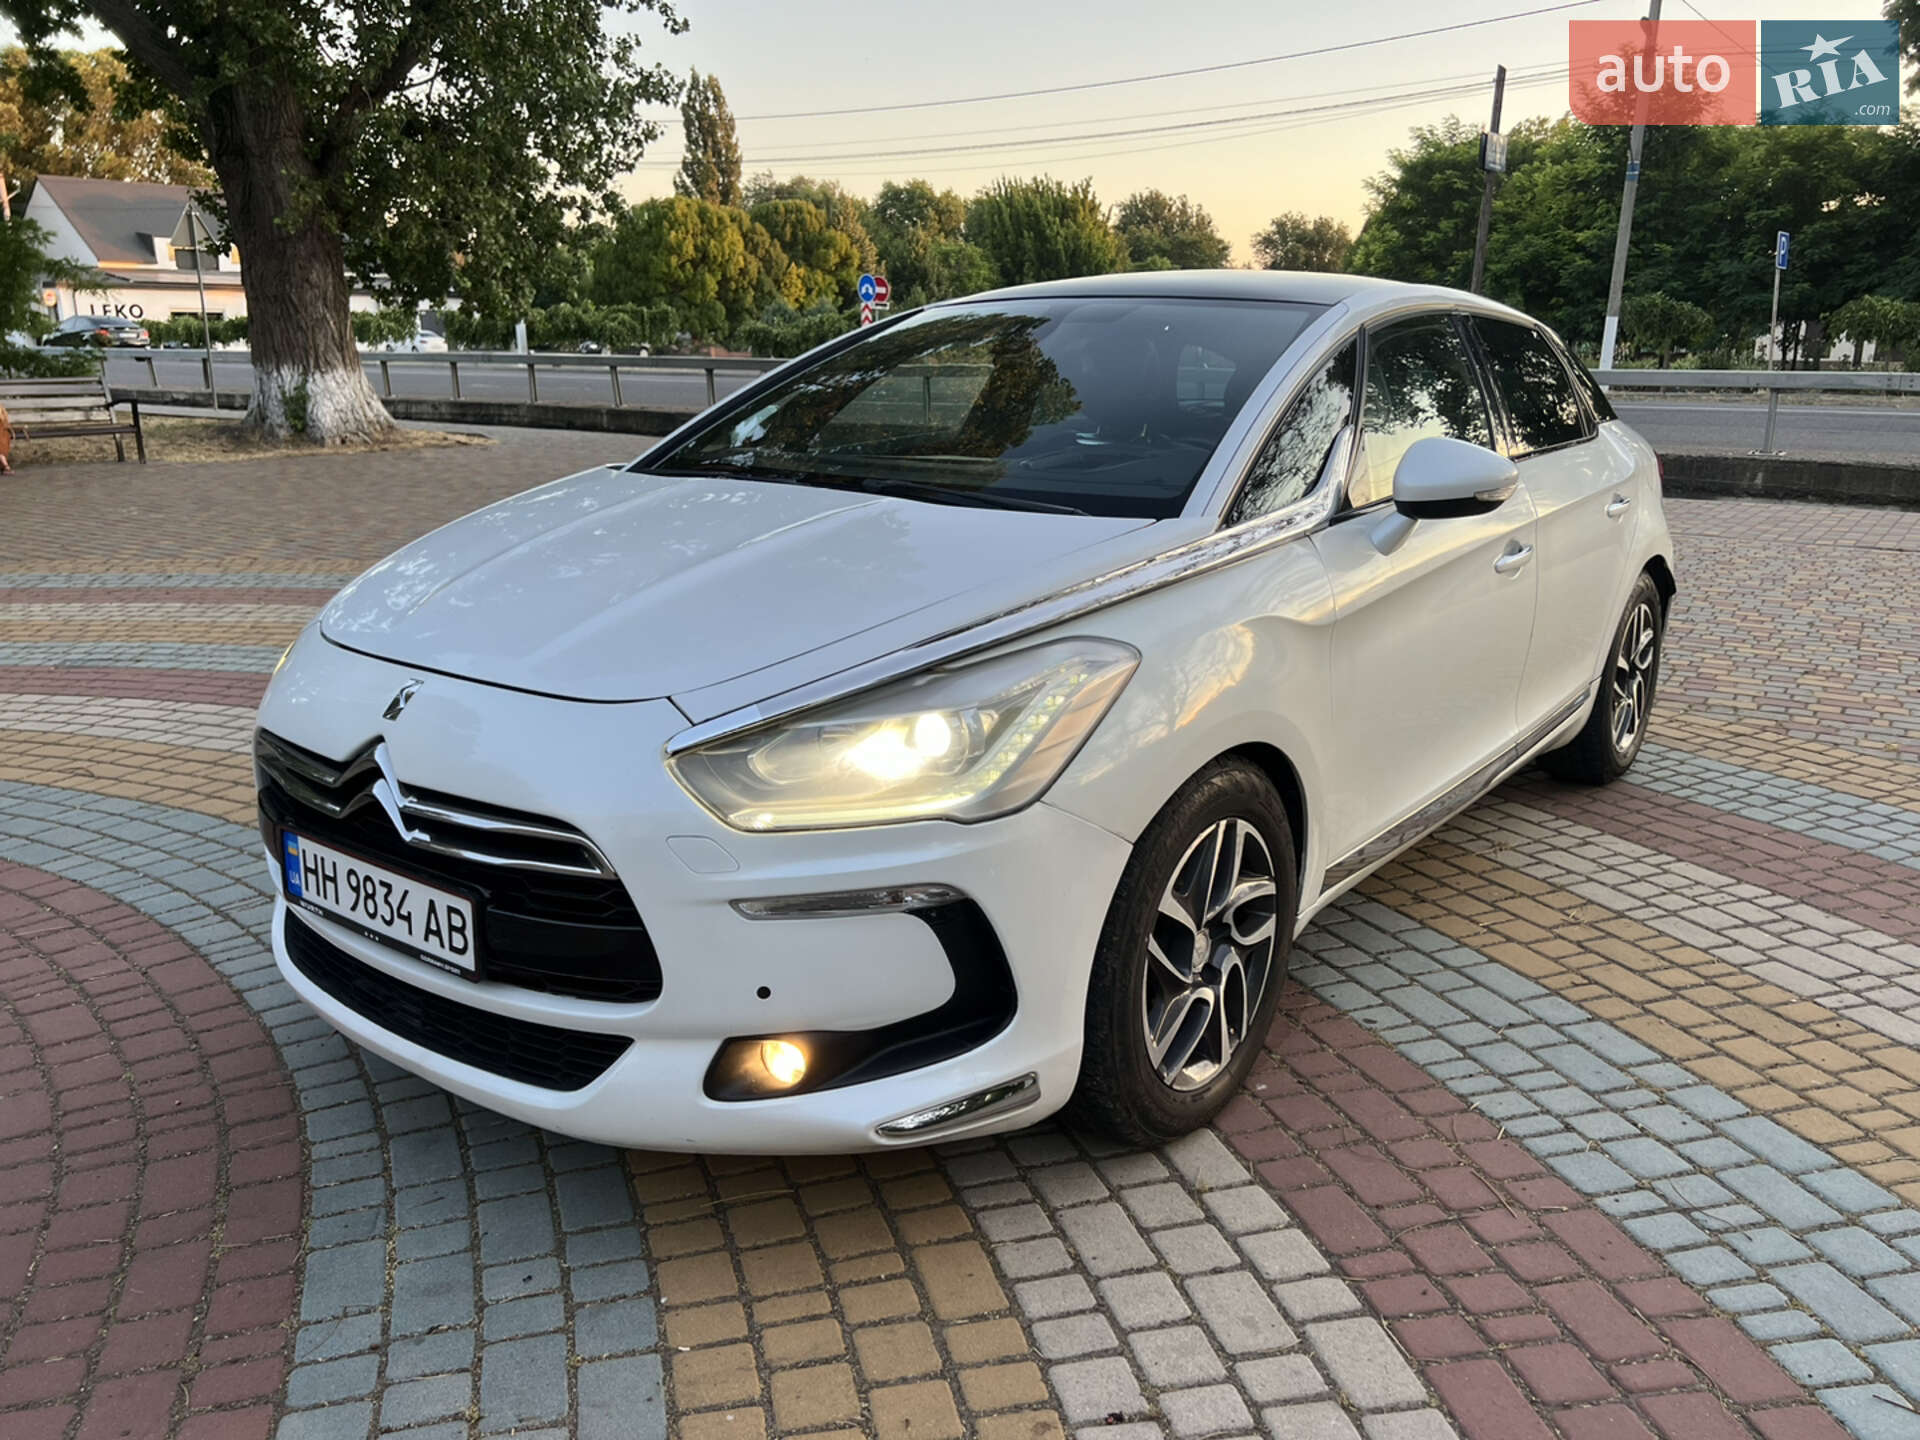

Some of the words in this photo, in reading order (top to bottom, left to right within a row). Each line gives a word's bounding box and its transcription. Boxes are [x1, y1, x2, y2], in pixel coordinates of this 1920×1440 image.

[289, 870, 301, 885] UA
[302, 849, 340, 906] HH
[346, 868, 413, 936] 9834
[423, 898, 468, 955] AB
